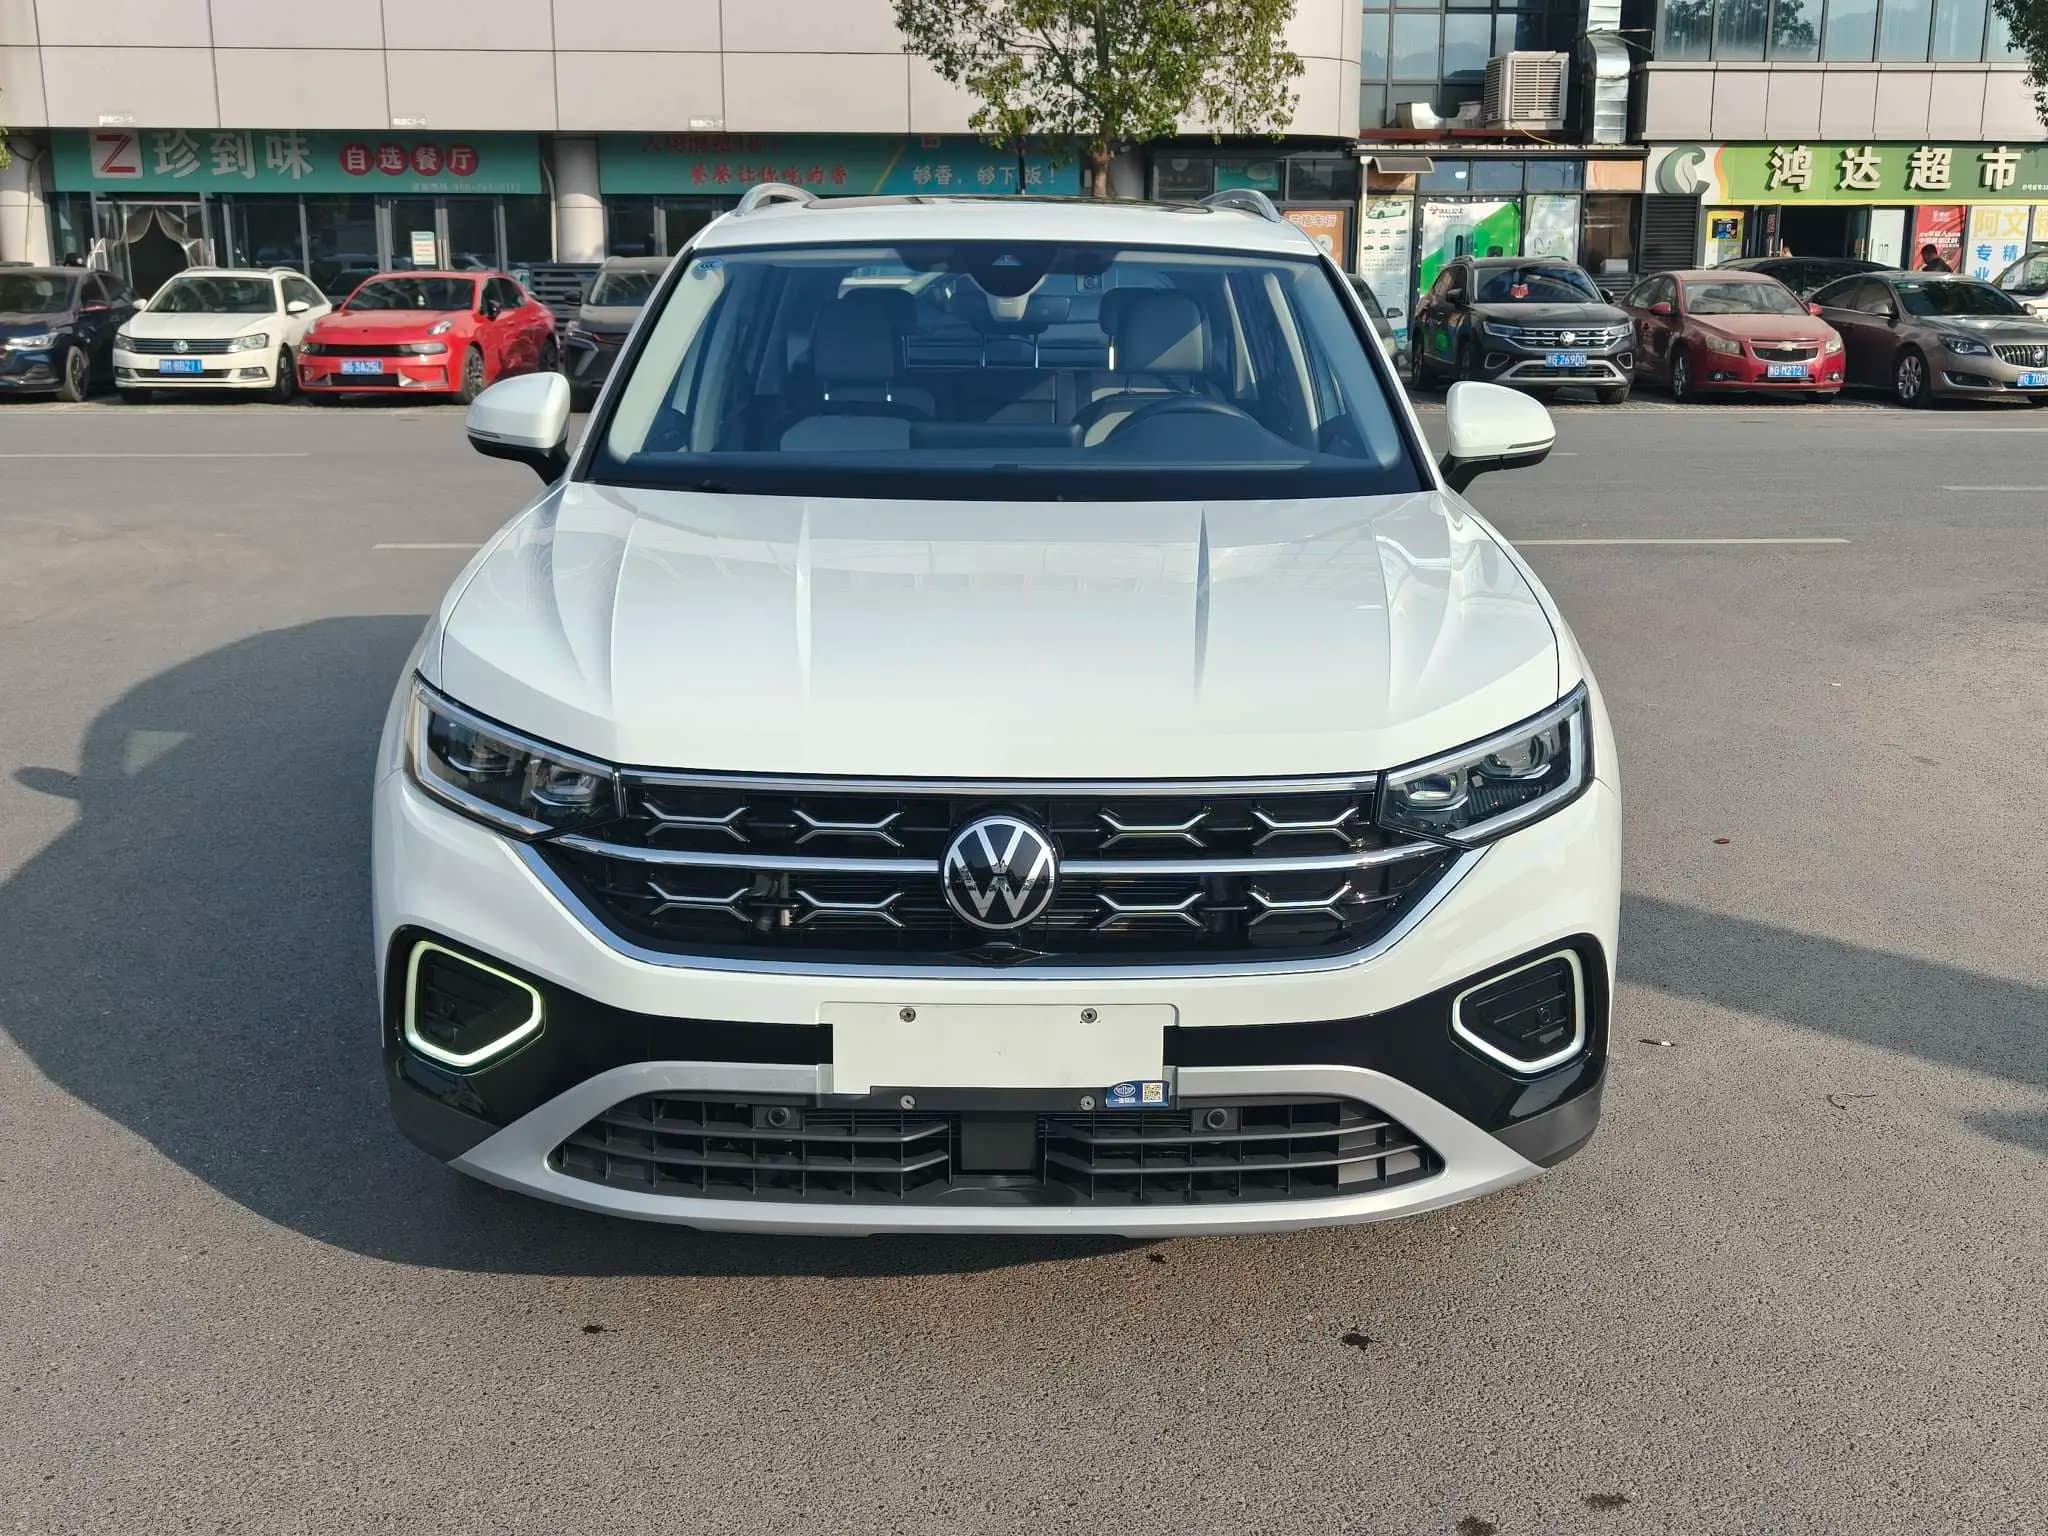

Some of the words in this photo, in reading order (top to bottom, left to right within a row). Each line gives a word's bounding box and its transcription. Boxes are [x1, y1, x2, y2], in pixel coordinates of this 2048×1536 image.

[152, 130, 313, 179] 珍到味
[347, 147, 472, 170] 自选餐厅
[1770, 145, 2021, 190] 鸿达超市
